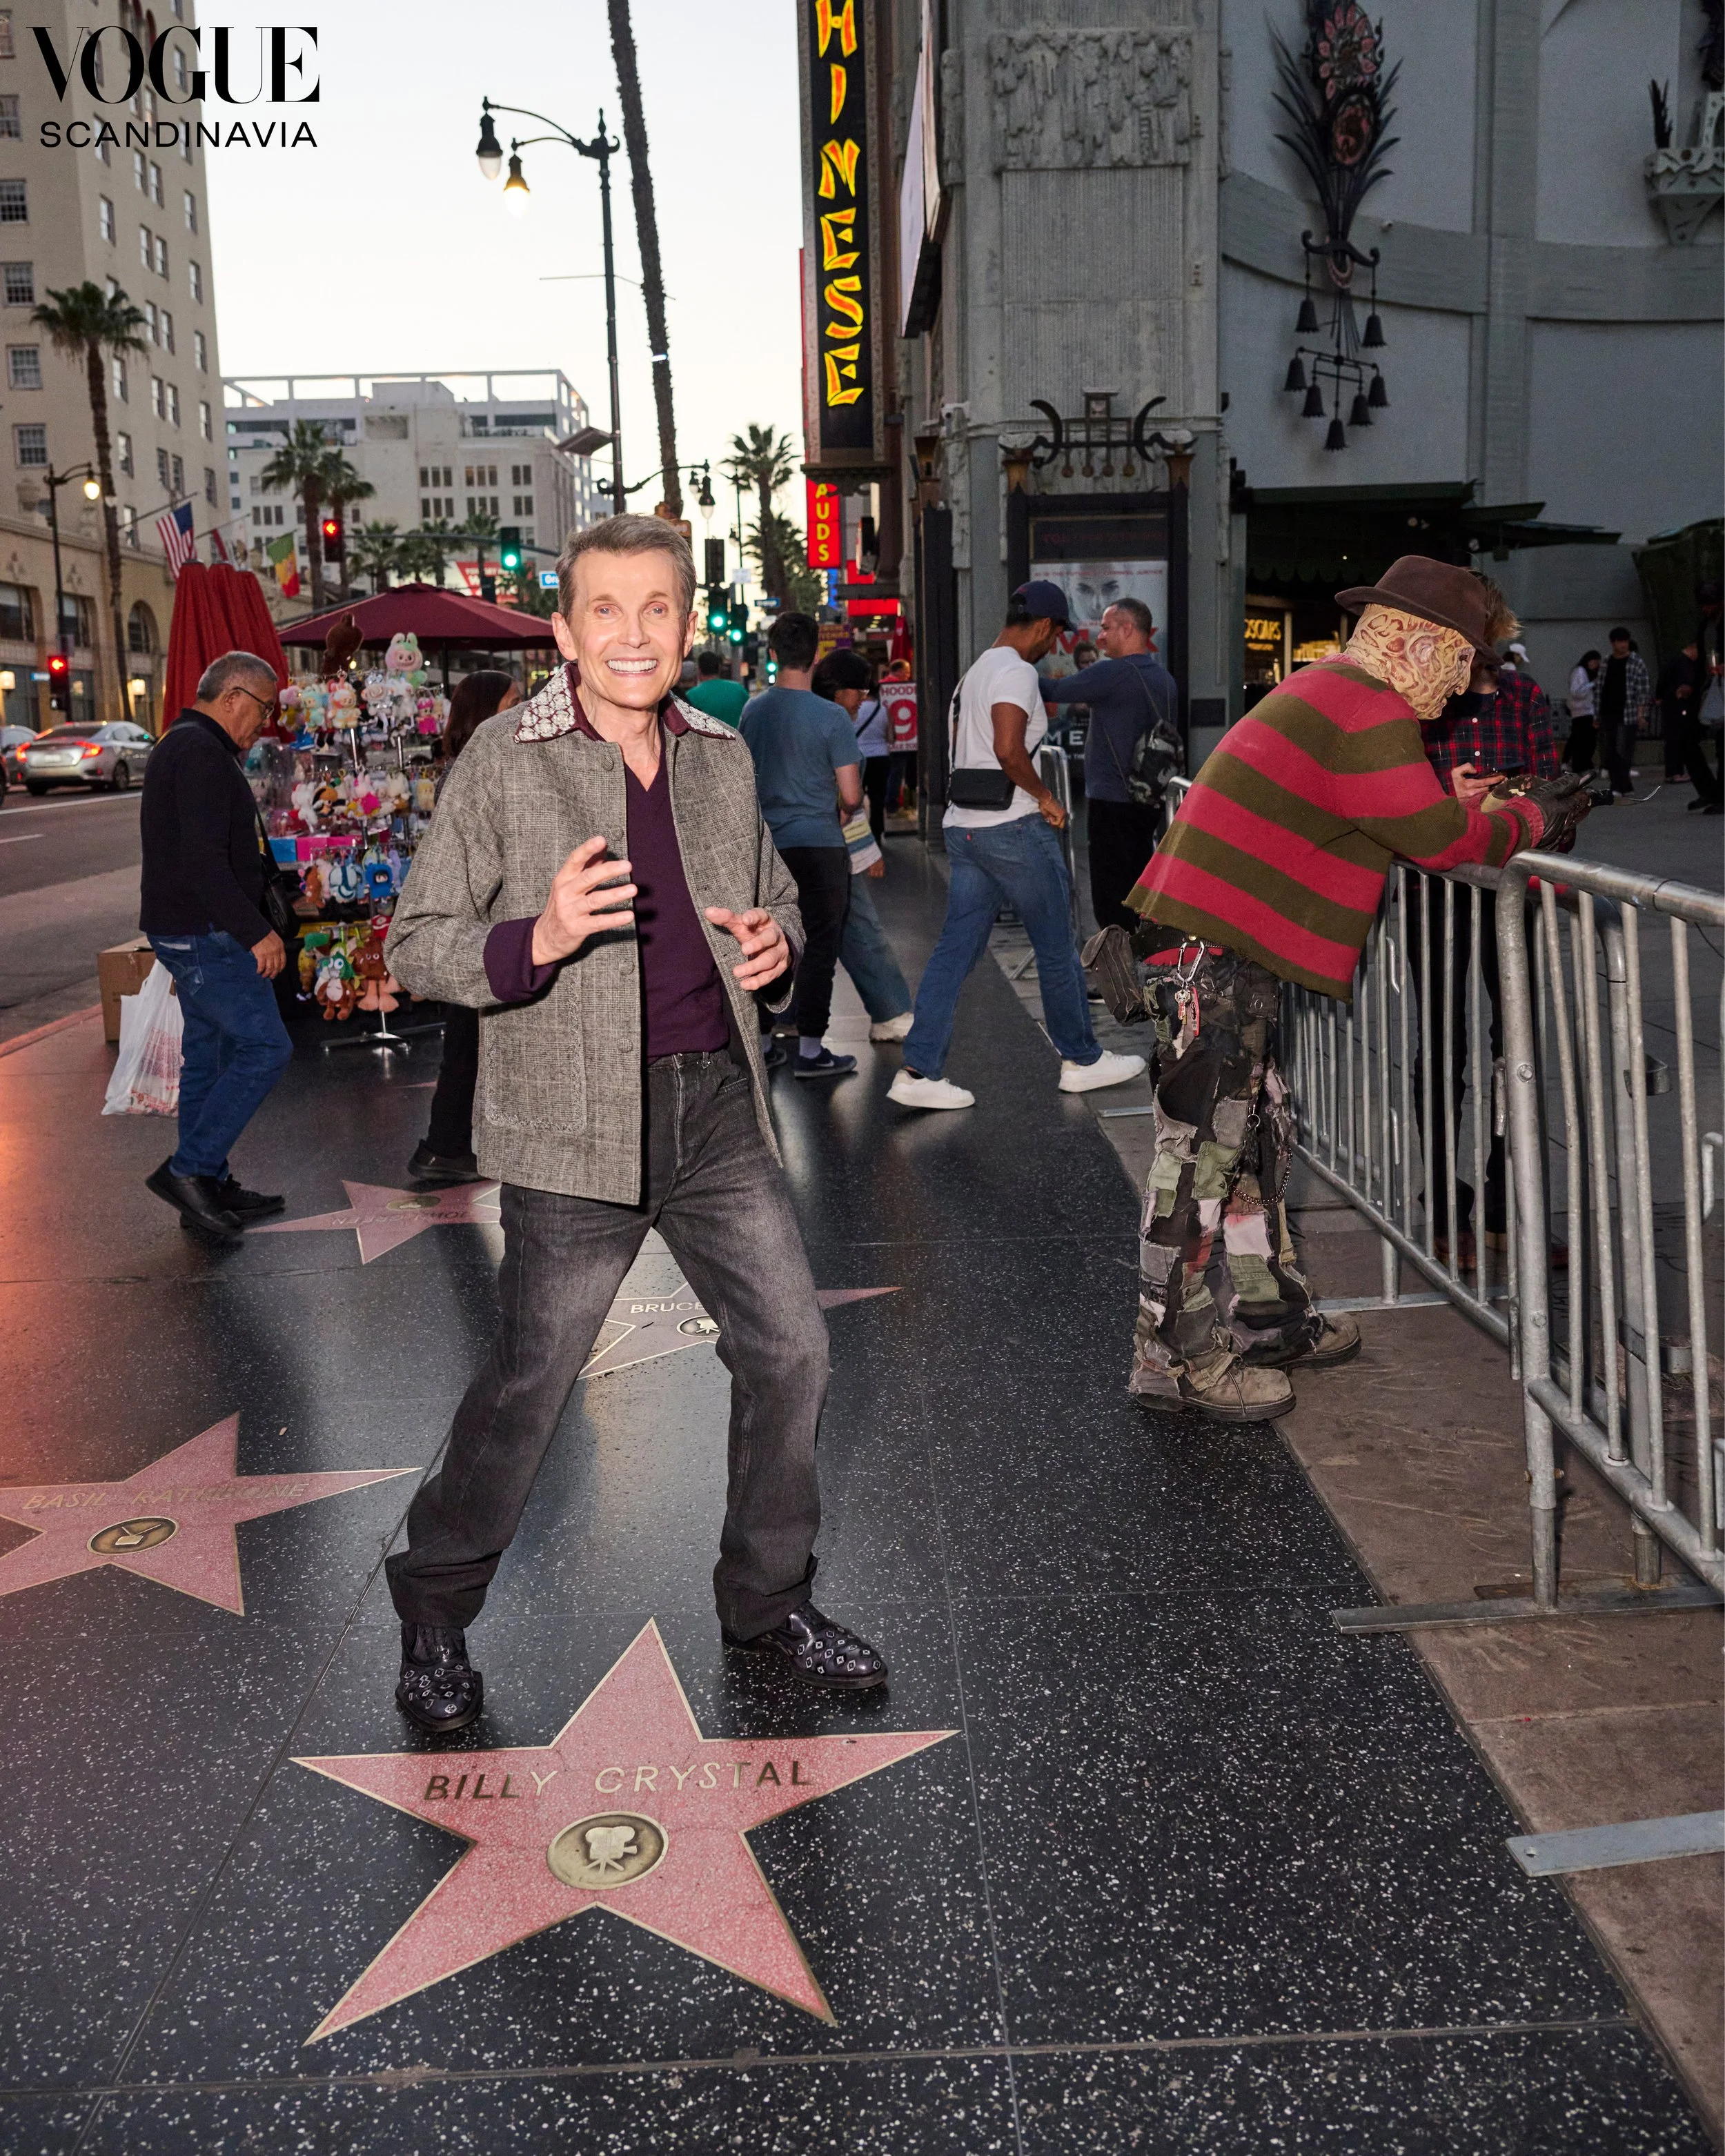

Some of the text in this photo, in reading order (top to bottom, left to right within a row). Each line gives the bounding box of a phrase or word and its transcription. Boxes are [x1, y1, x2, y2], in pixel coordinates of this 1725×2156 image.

[630, 1301, 705, 1314] BRUCE
[22, 1483, 310, 1510] BASIL RATHBONE
[423, 1760, 815, 1801] BILLY CRYSTAL
